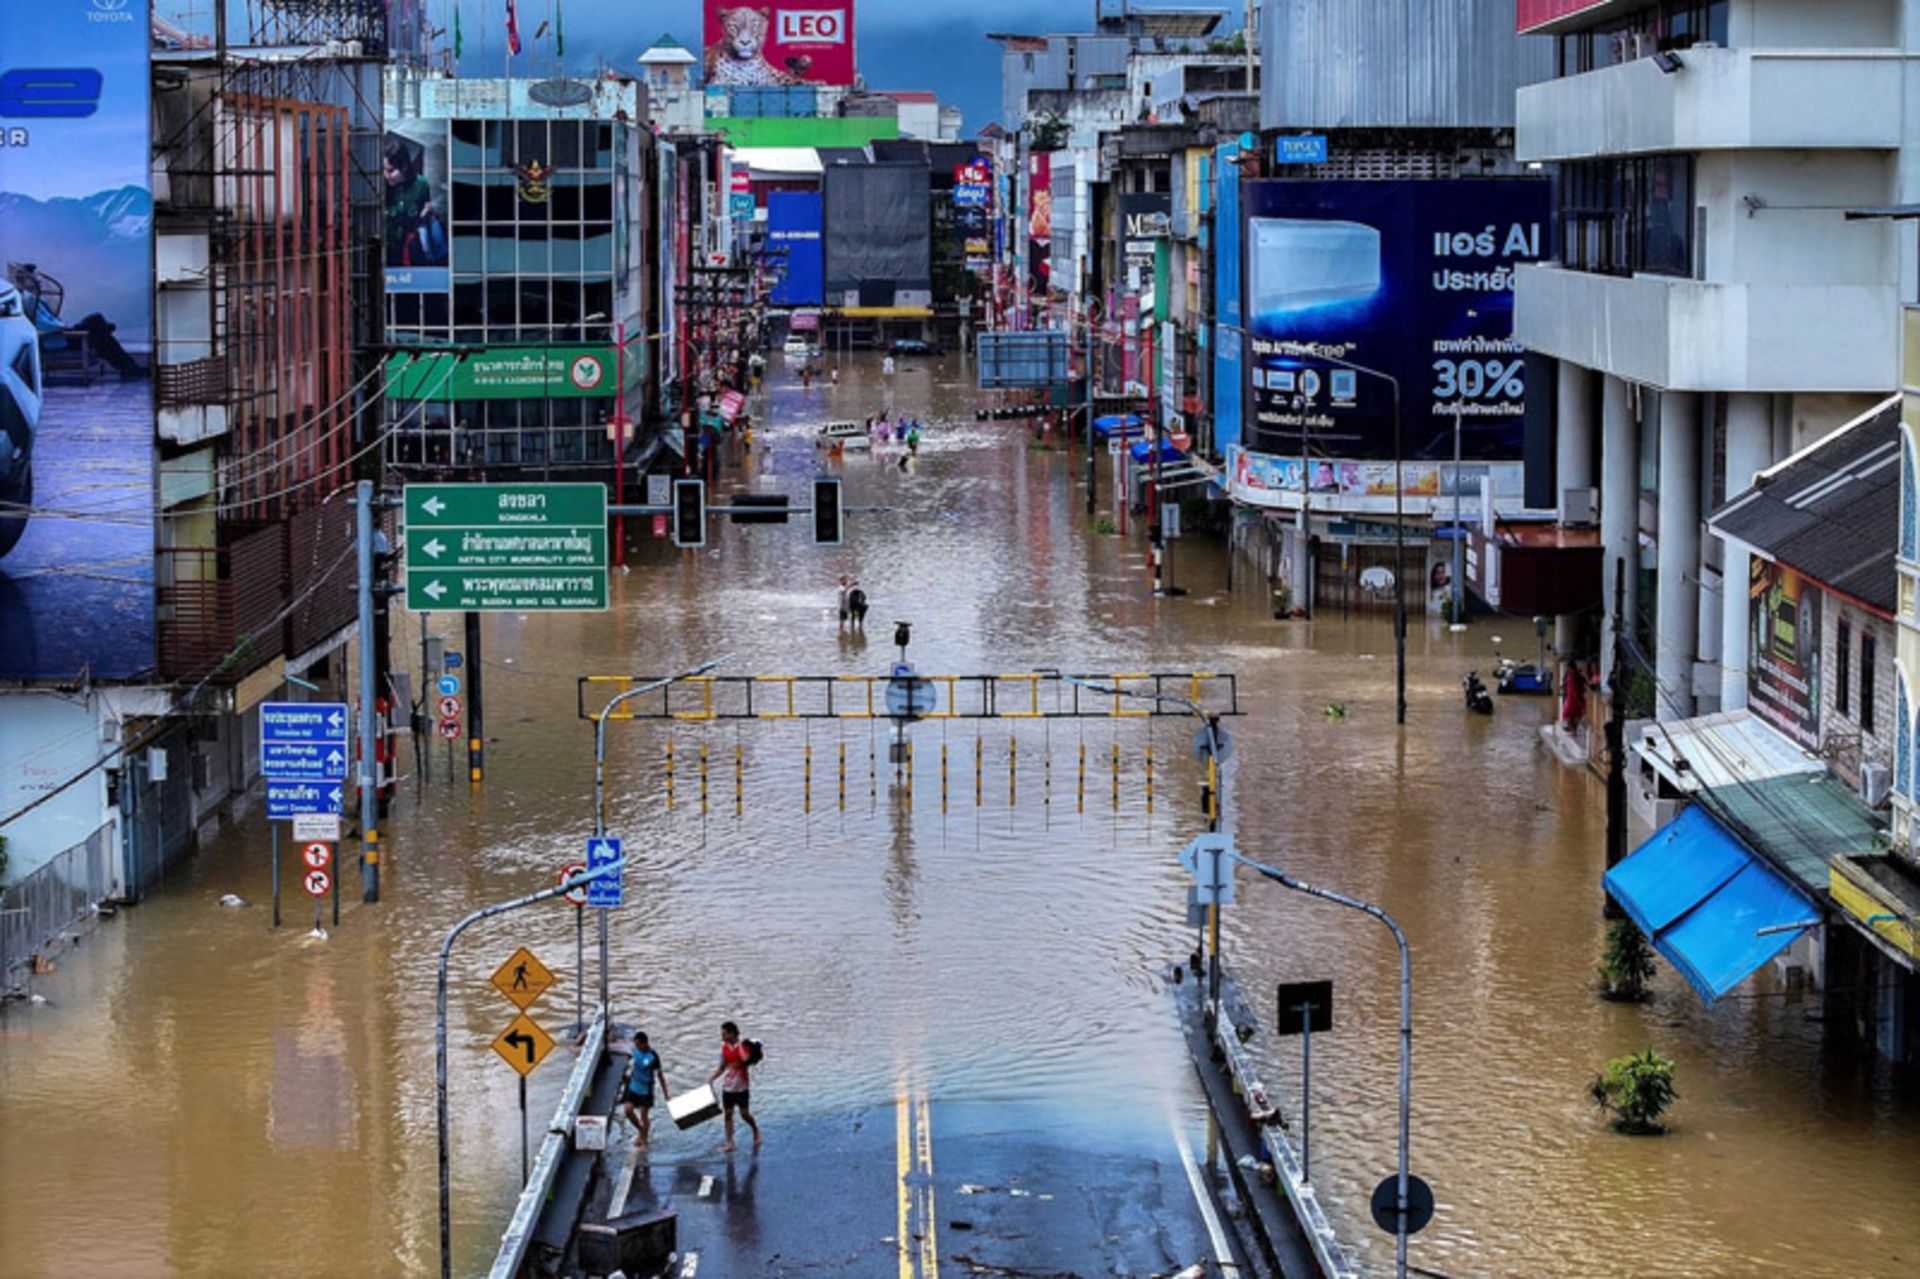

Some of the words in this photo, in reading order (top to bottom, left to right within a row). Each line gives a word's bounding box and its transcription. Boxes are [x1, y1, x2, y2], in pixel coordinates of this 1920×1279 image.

[87, 12, 134, 22] TOYOTA
[784, 15, 837, 37] LEO
[0, 128, 28, 147] R
[1434, 225, 1496, 257] แอร์
[1502, 222, 1540, 257] AI
[1432, 359, 1525, 398] 30%
[498, 493, 547, 509] สงขลา
[498, 513, 547, 522] SONGKHLA
[489, 556, 507, 564] CITY
[510, 556, 564, 564] MUNICIPALITY
[567, 555, 594, 564] OFFICE
